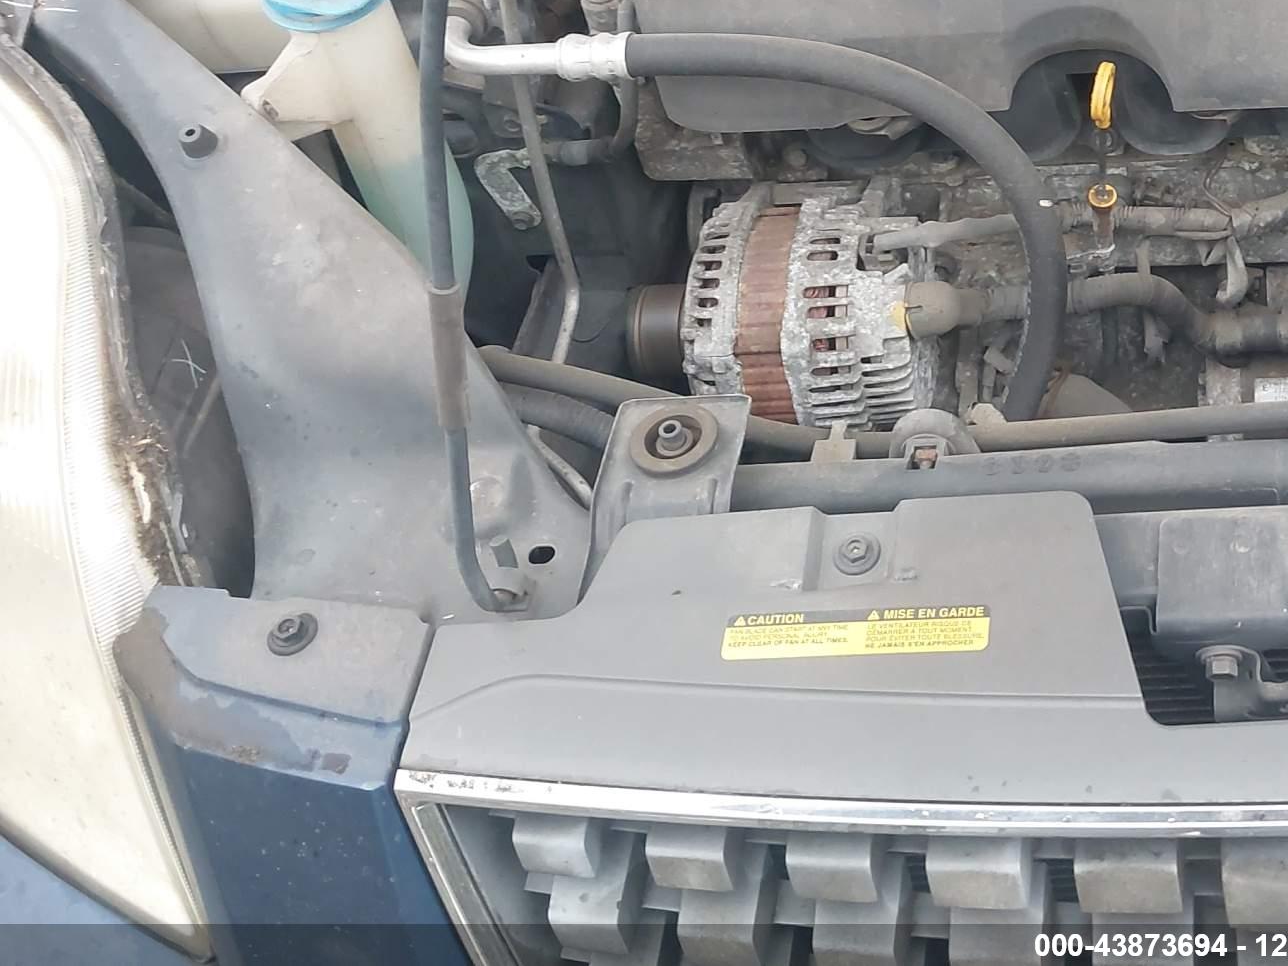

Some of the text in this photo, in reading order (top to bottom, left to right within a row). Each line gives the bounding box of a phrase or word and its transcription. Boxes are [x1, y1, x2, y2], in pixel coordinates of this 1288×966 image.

[883, 606, 985, 619] MISE EN GARDE
[747, 613, 804, 626] CAUTION
